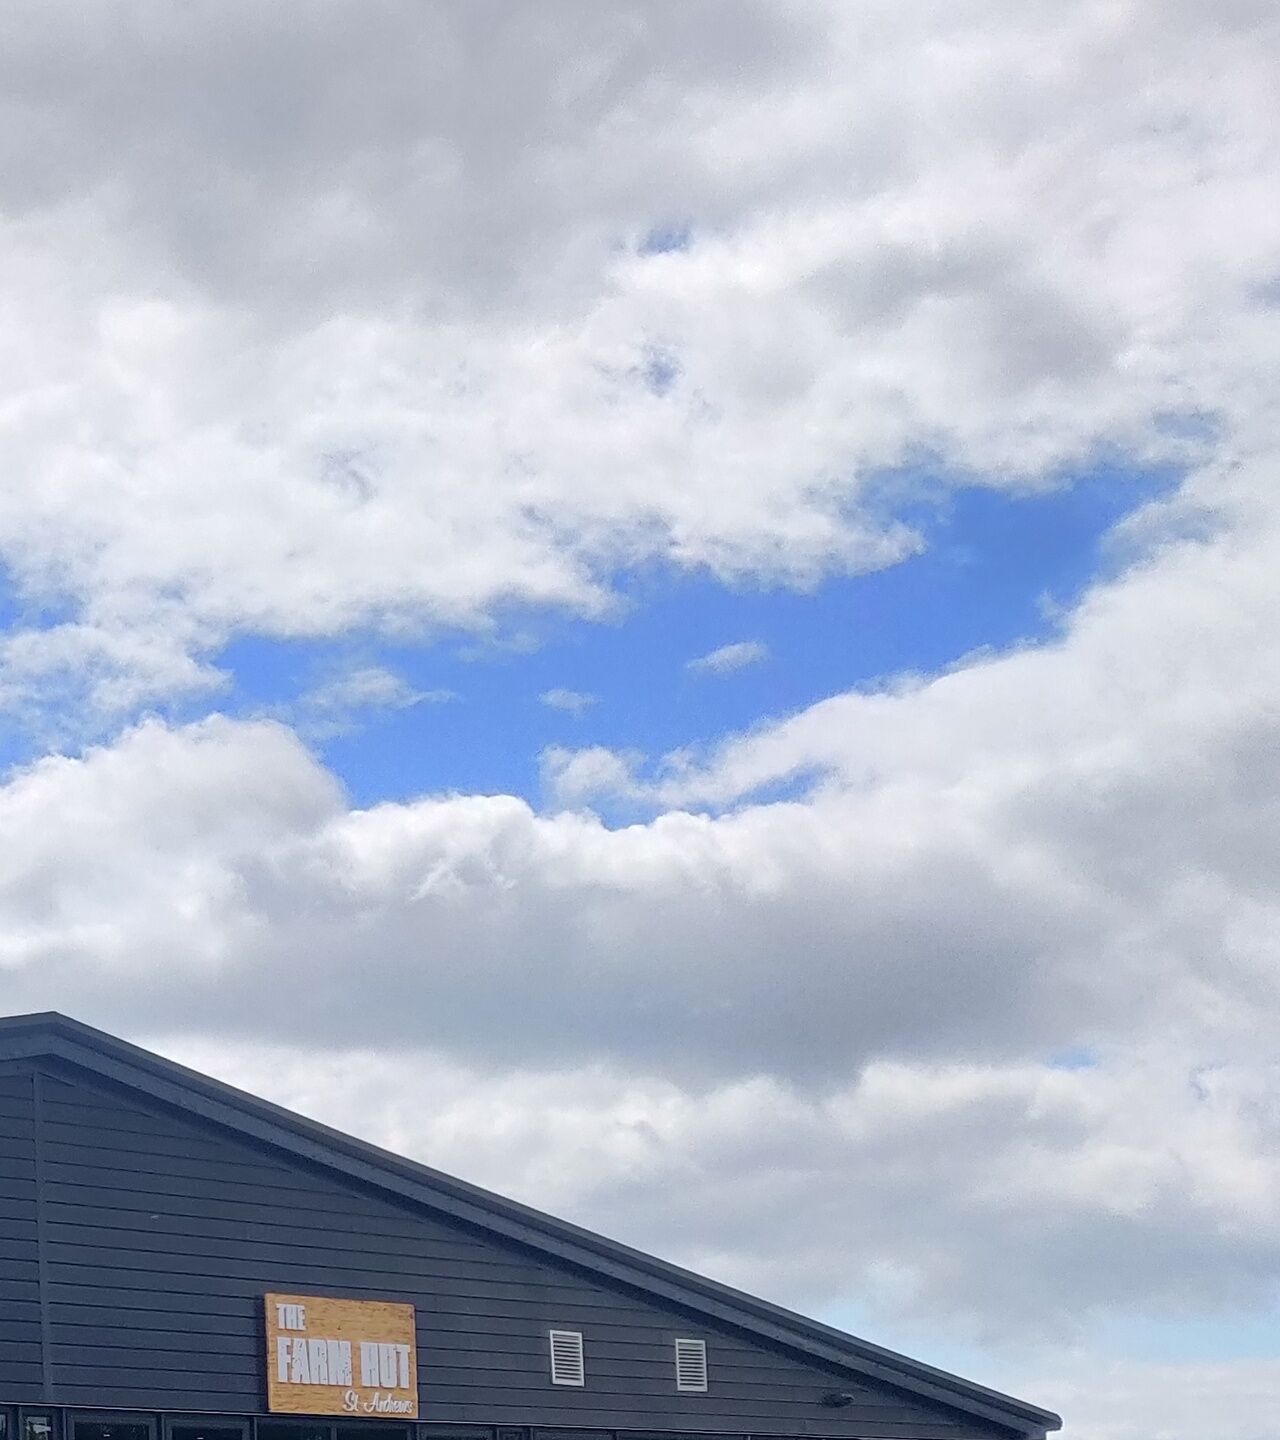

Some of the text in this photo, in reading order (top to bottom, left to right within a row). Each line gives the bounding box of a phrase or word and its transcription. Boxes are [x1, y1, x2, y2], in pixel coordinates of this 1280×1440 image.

[276, 1303, 306, 1331] THE
[277, 1336, 412, 1389] FARM HUT
[363, 1392, 414, 1414] Andrews
